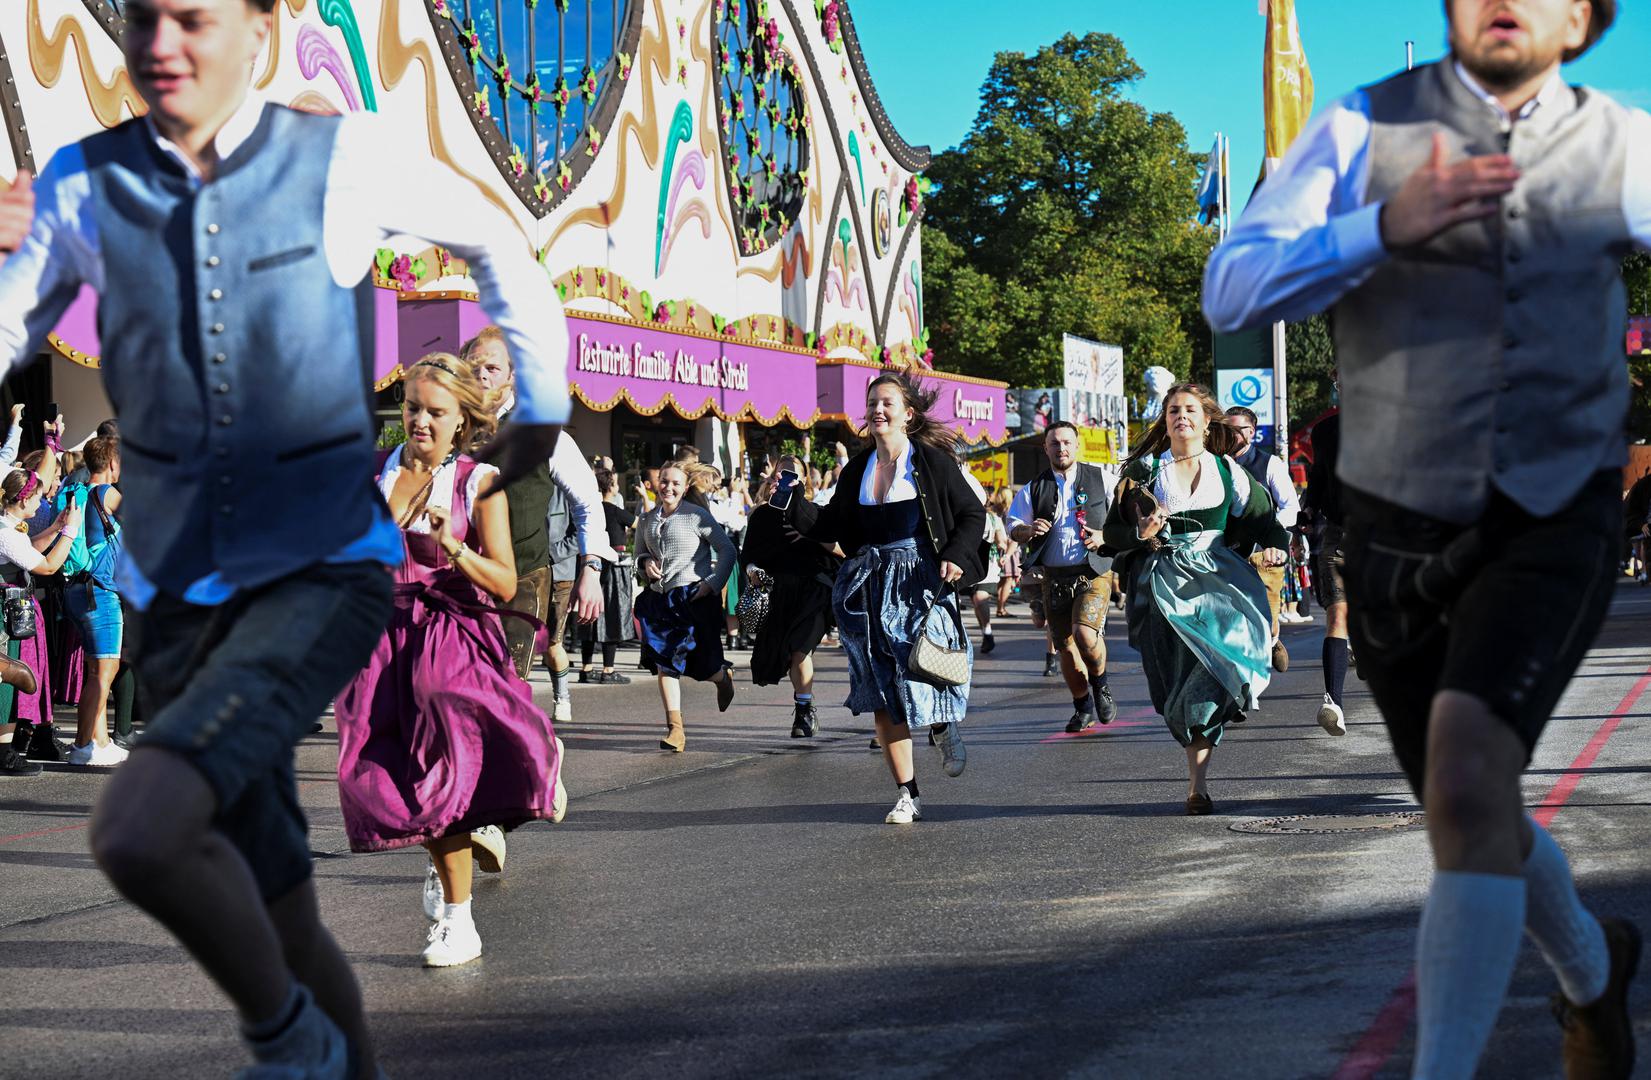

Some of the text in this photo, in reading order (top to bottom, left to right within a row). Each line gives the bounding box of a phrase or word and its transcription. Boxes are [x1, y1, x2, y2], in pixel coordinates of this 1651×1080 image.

[578, 332, 749, 391] Festwirte Familie Able und Strobl
